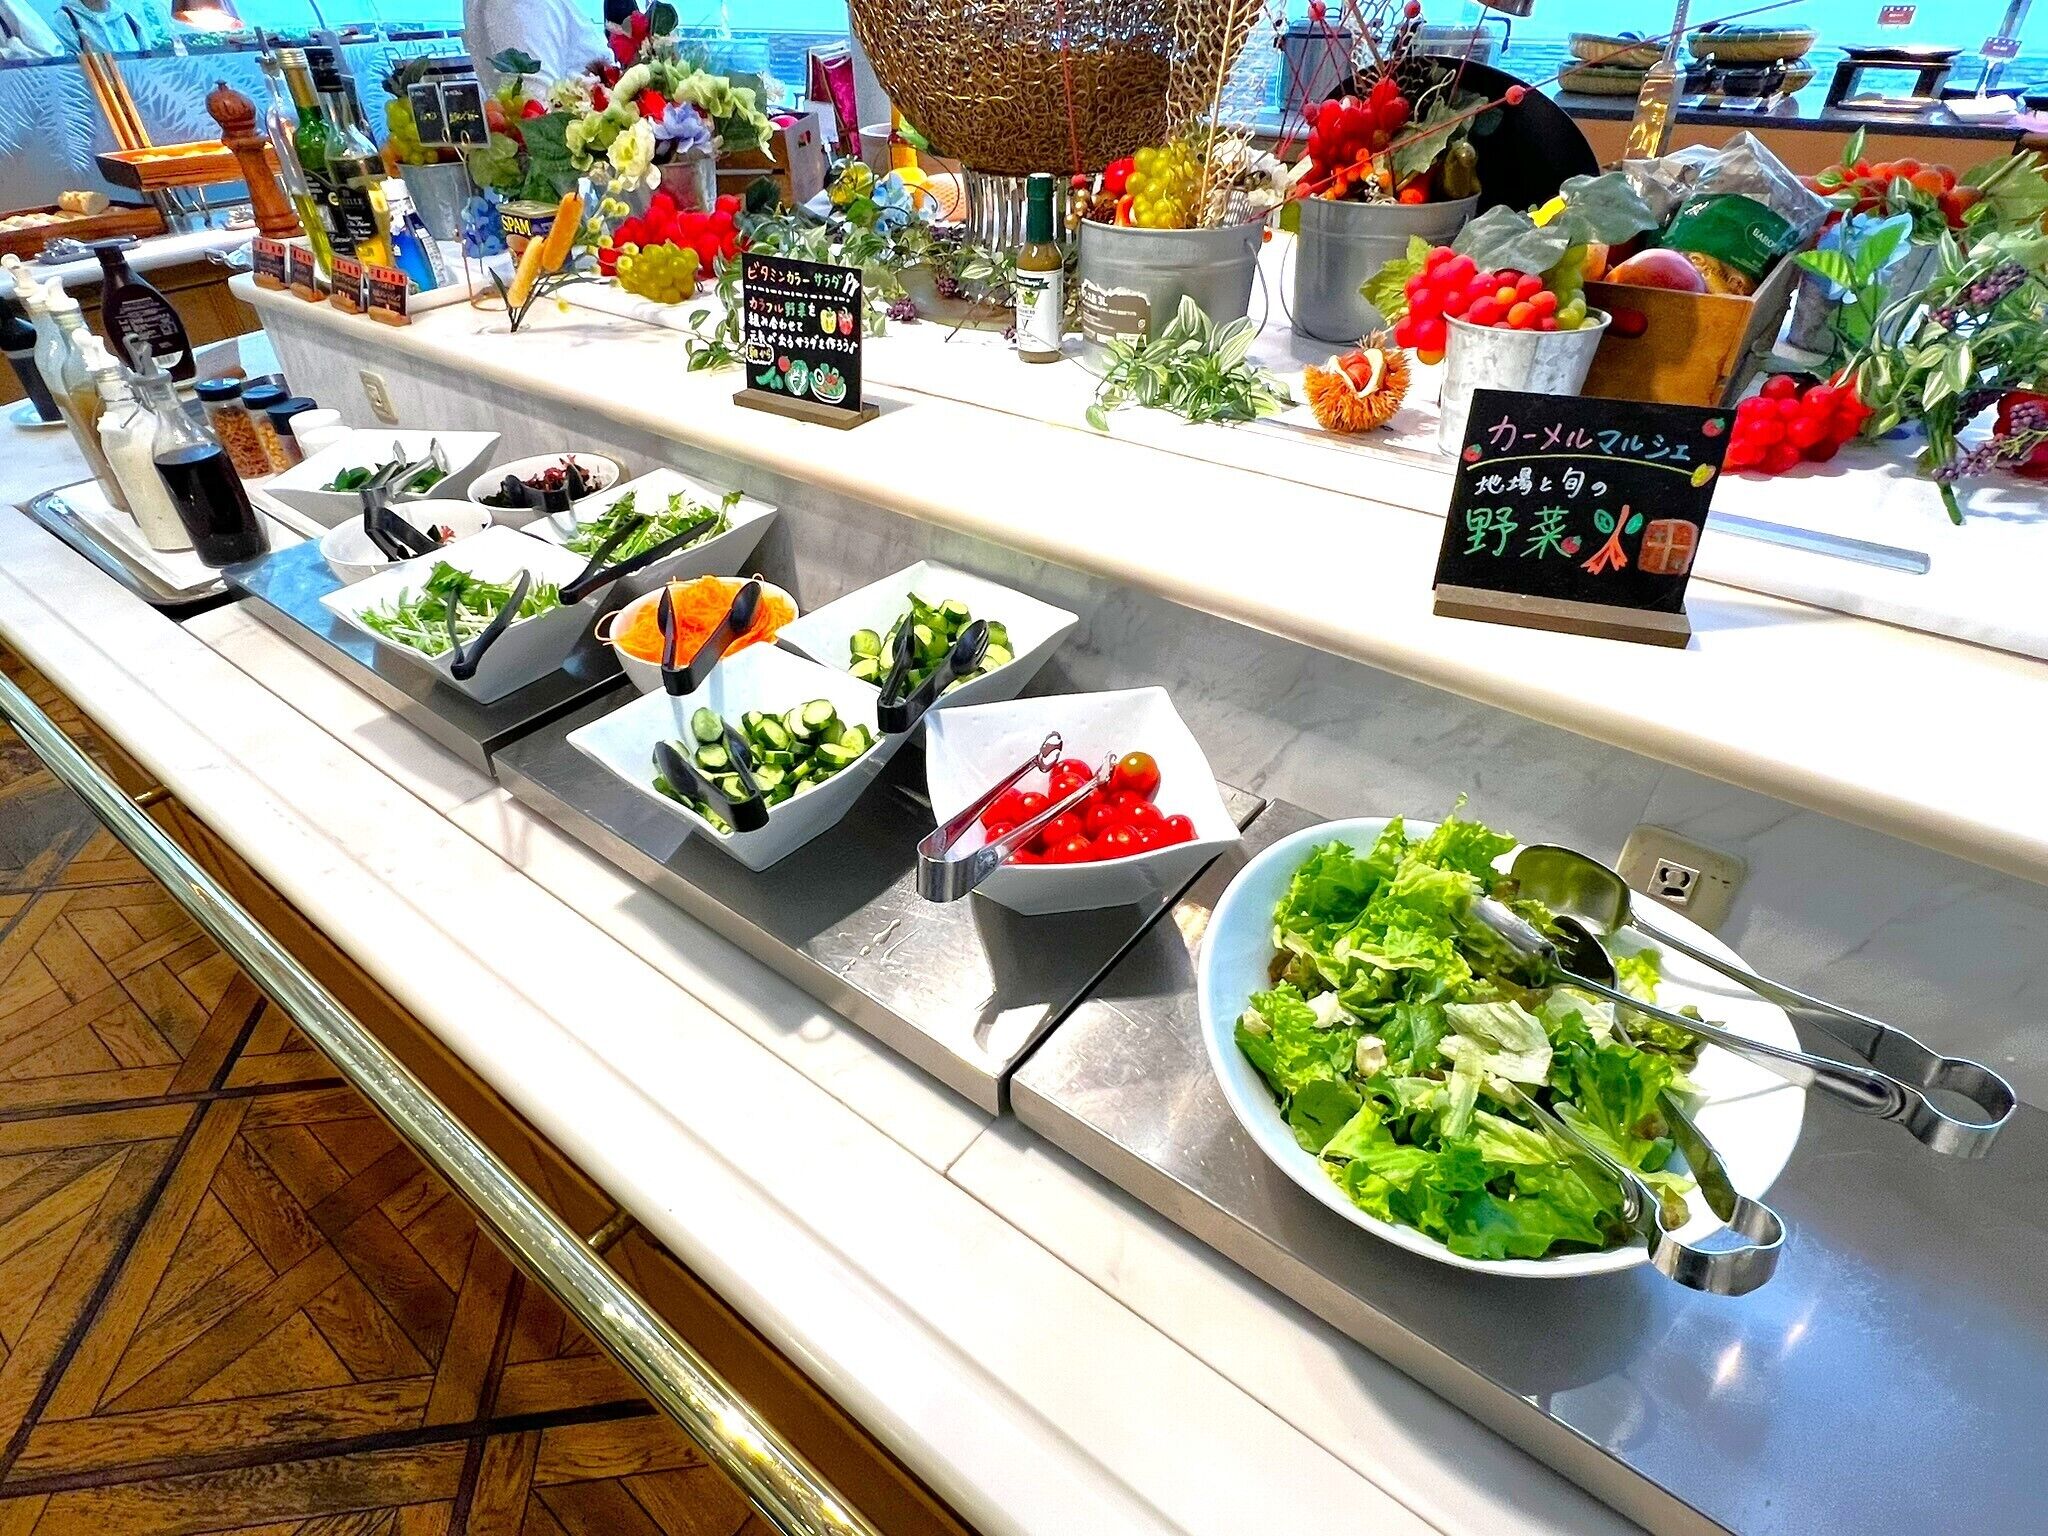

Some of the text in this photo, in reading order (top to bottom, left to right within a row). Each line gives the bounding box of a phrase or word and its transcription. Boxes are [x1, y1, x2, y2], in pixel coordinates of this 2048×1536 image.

[501, 215, 532, 236] SPAM
[1474, 466, 1608, 499] 地場と旬の
[1463, 505, 1572, 560] 野菜
